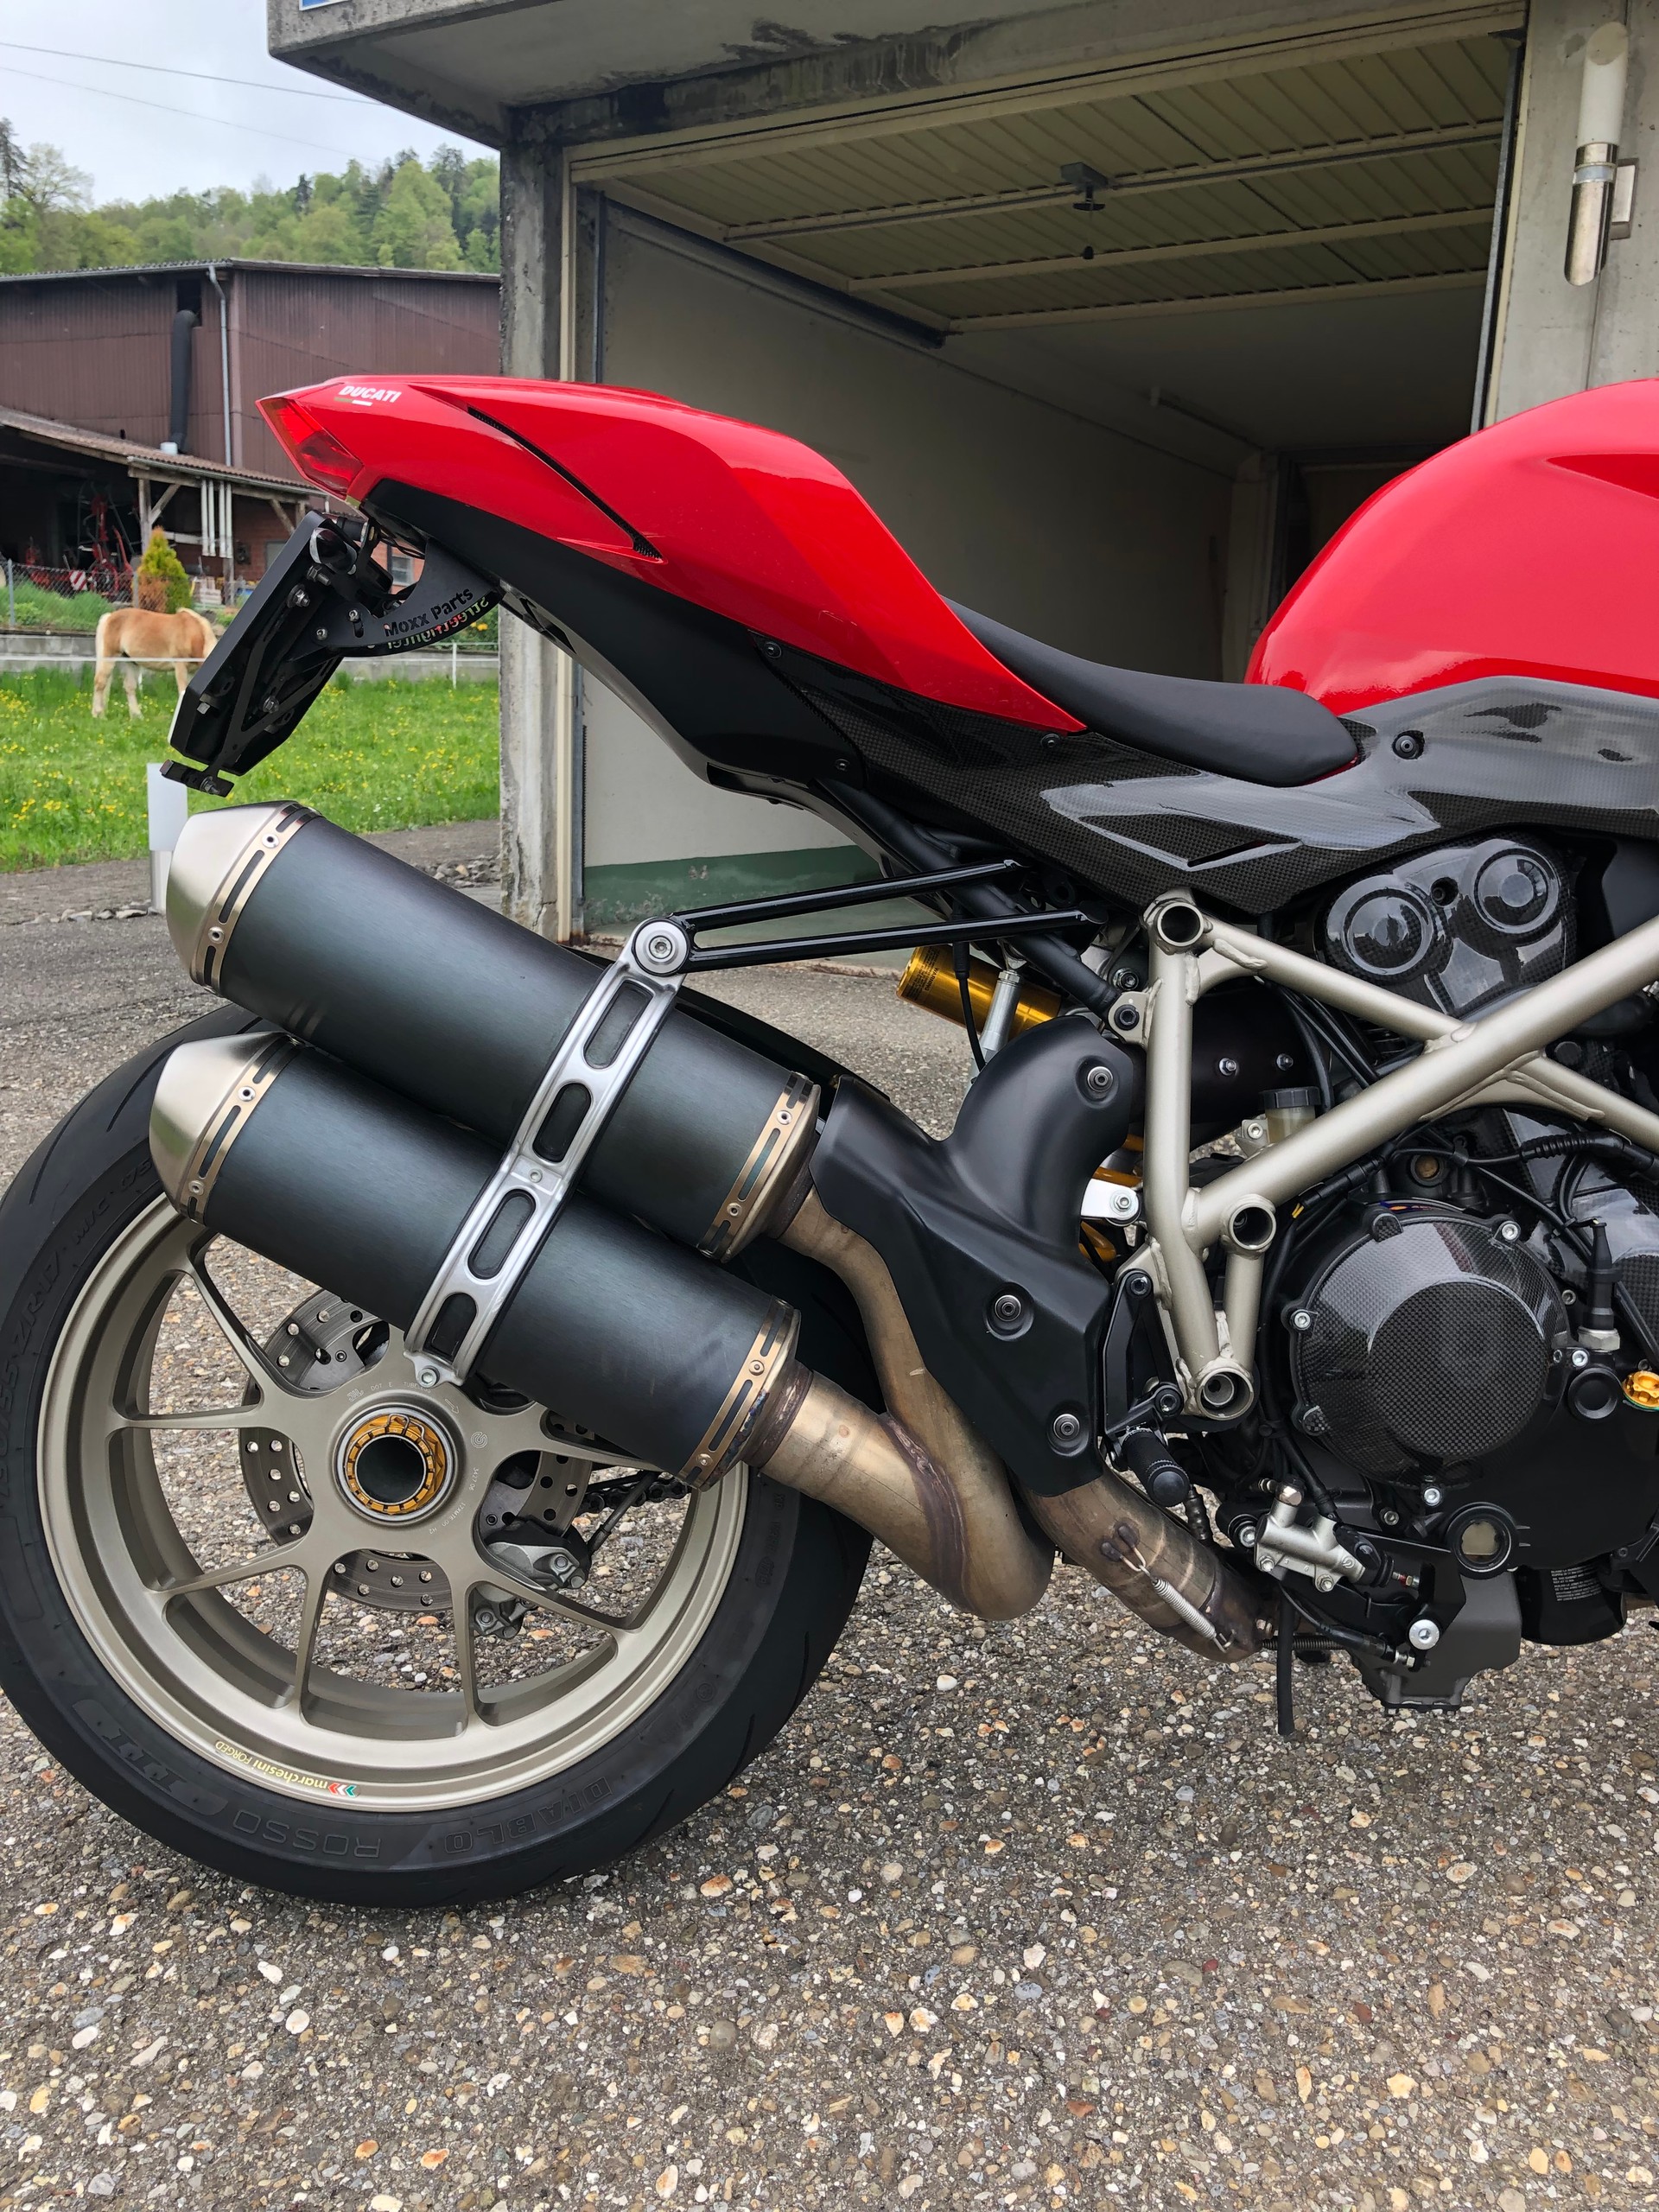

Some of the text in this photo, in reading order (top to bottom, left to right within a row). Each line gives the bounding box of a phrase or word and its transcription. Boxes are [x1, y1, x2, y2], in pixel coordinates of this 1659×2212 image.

[338, 385, 402, 403] DUCATI
[384, 588, 474, 637] Moxx Parts
[924, 966, 940, 991] WARNING
[215, 1740, 327, 1789] marchesini FORGED
[232, 1809, 382, 1859] ROSSO
[444, 1777, 613, 1853] DIABLO
